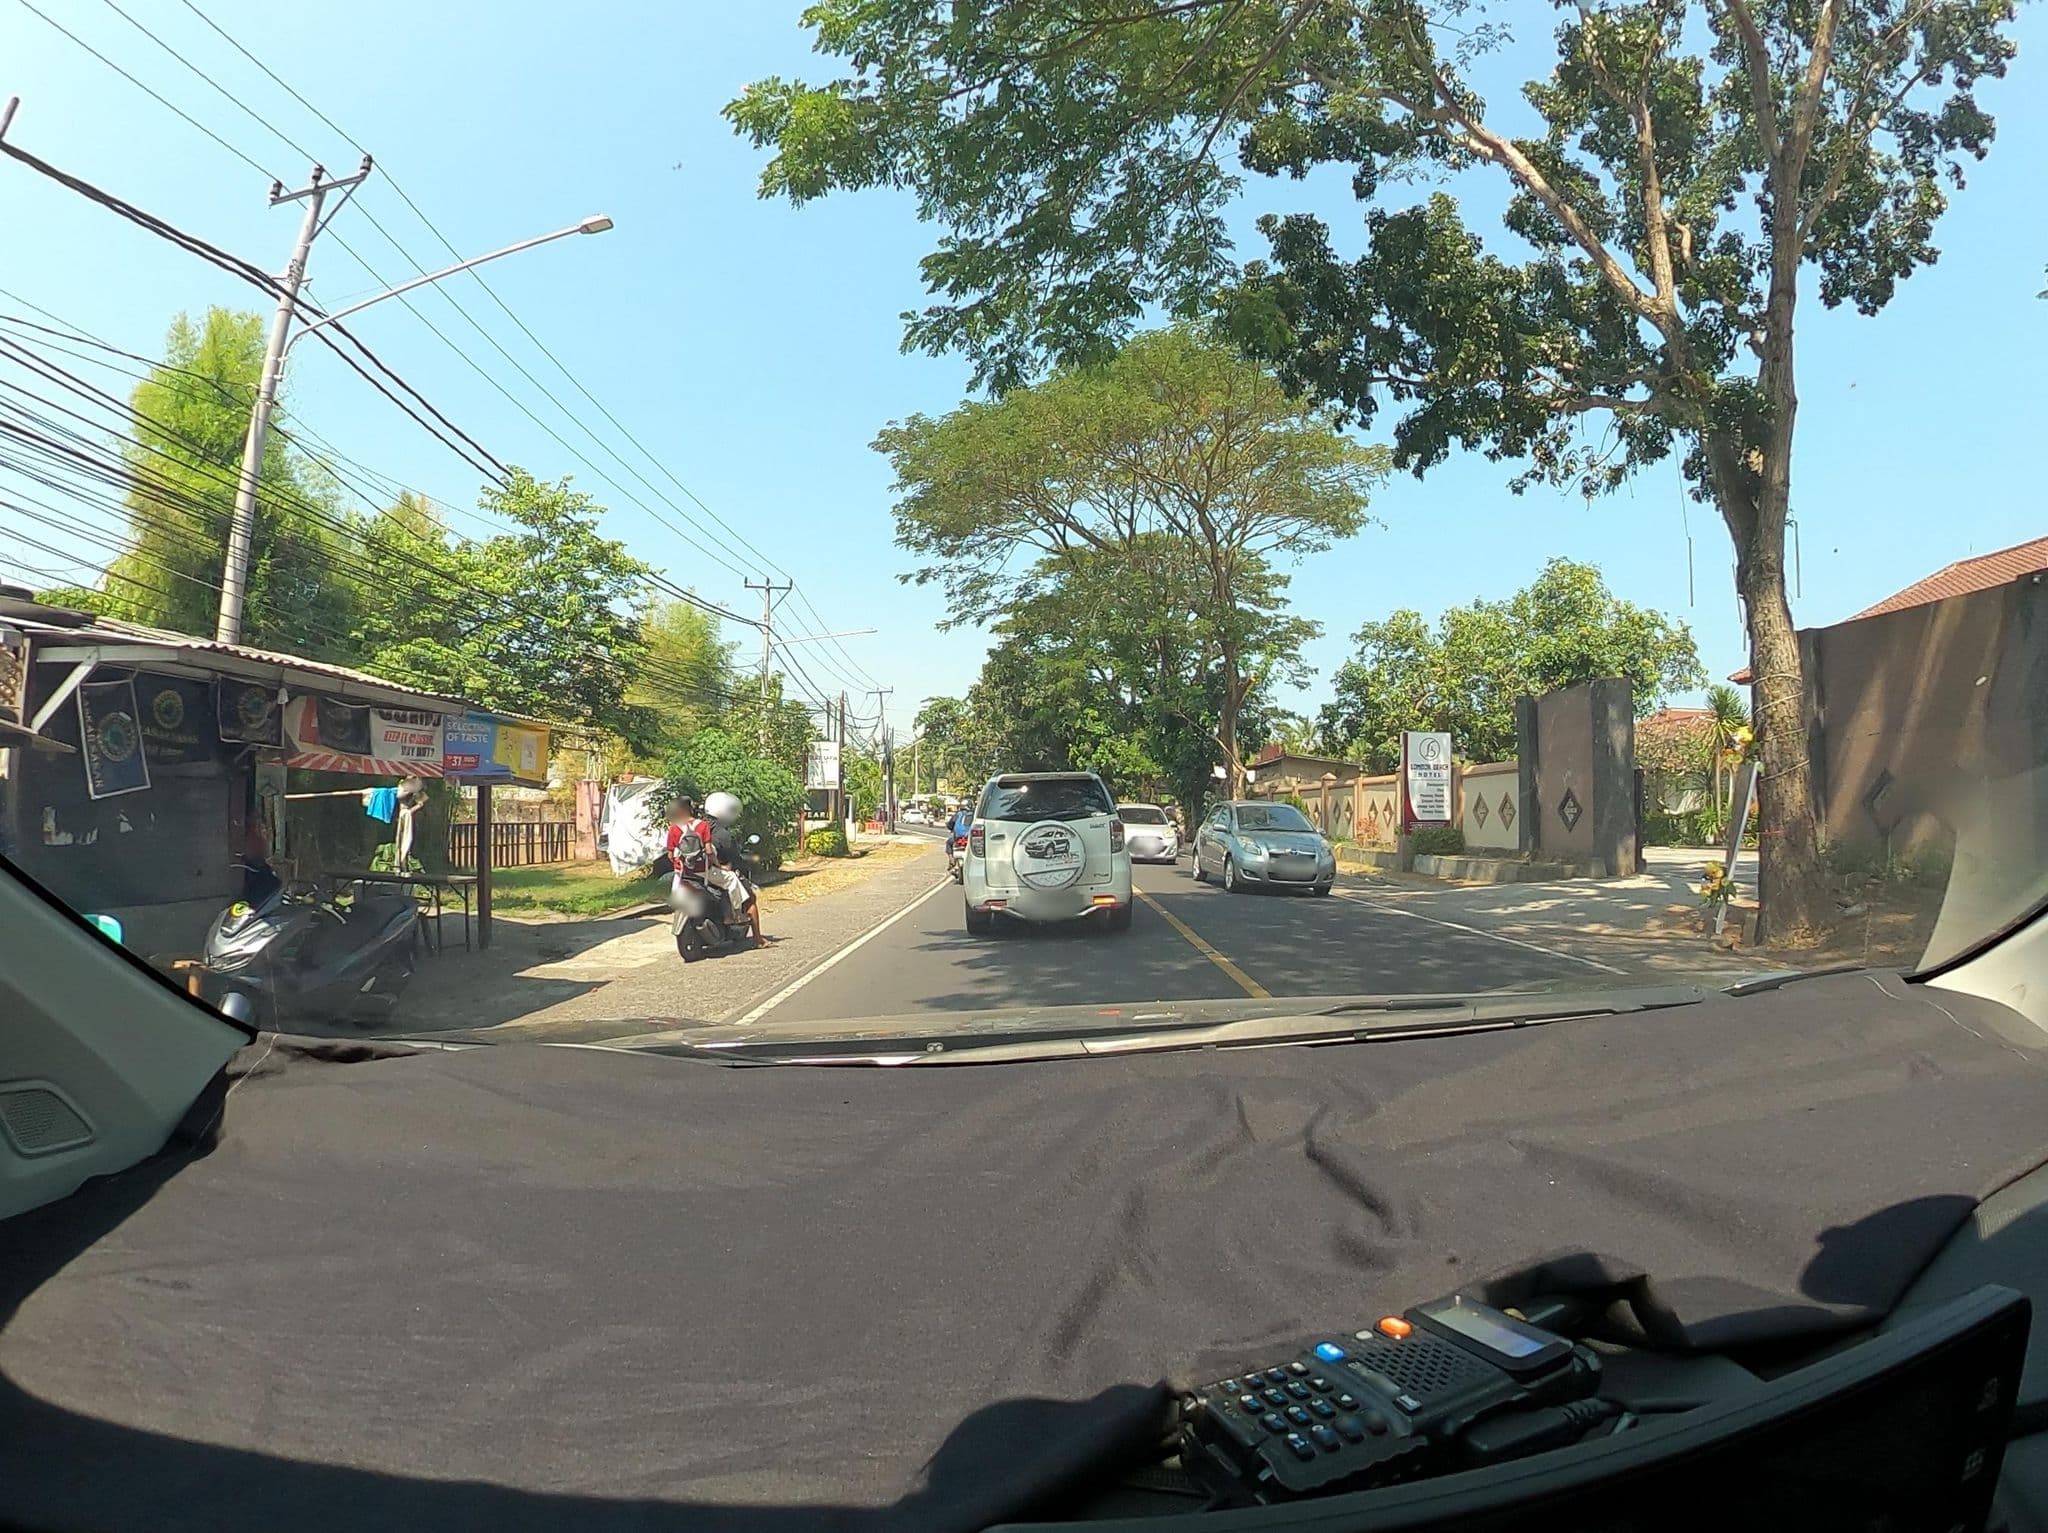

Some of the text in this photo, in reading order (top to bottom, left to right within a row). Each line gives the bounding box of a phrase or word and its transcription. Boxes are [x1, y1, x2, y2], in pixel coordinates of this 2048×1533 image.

[447, 721, 490, 732] SELECTION
[446, 733, 489, 743] OF TASTE
